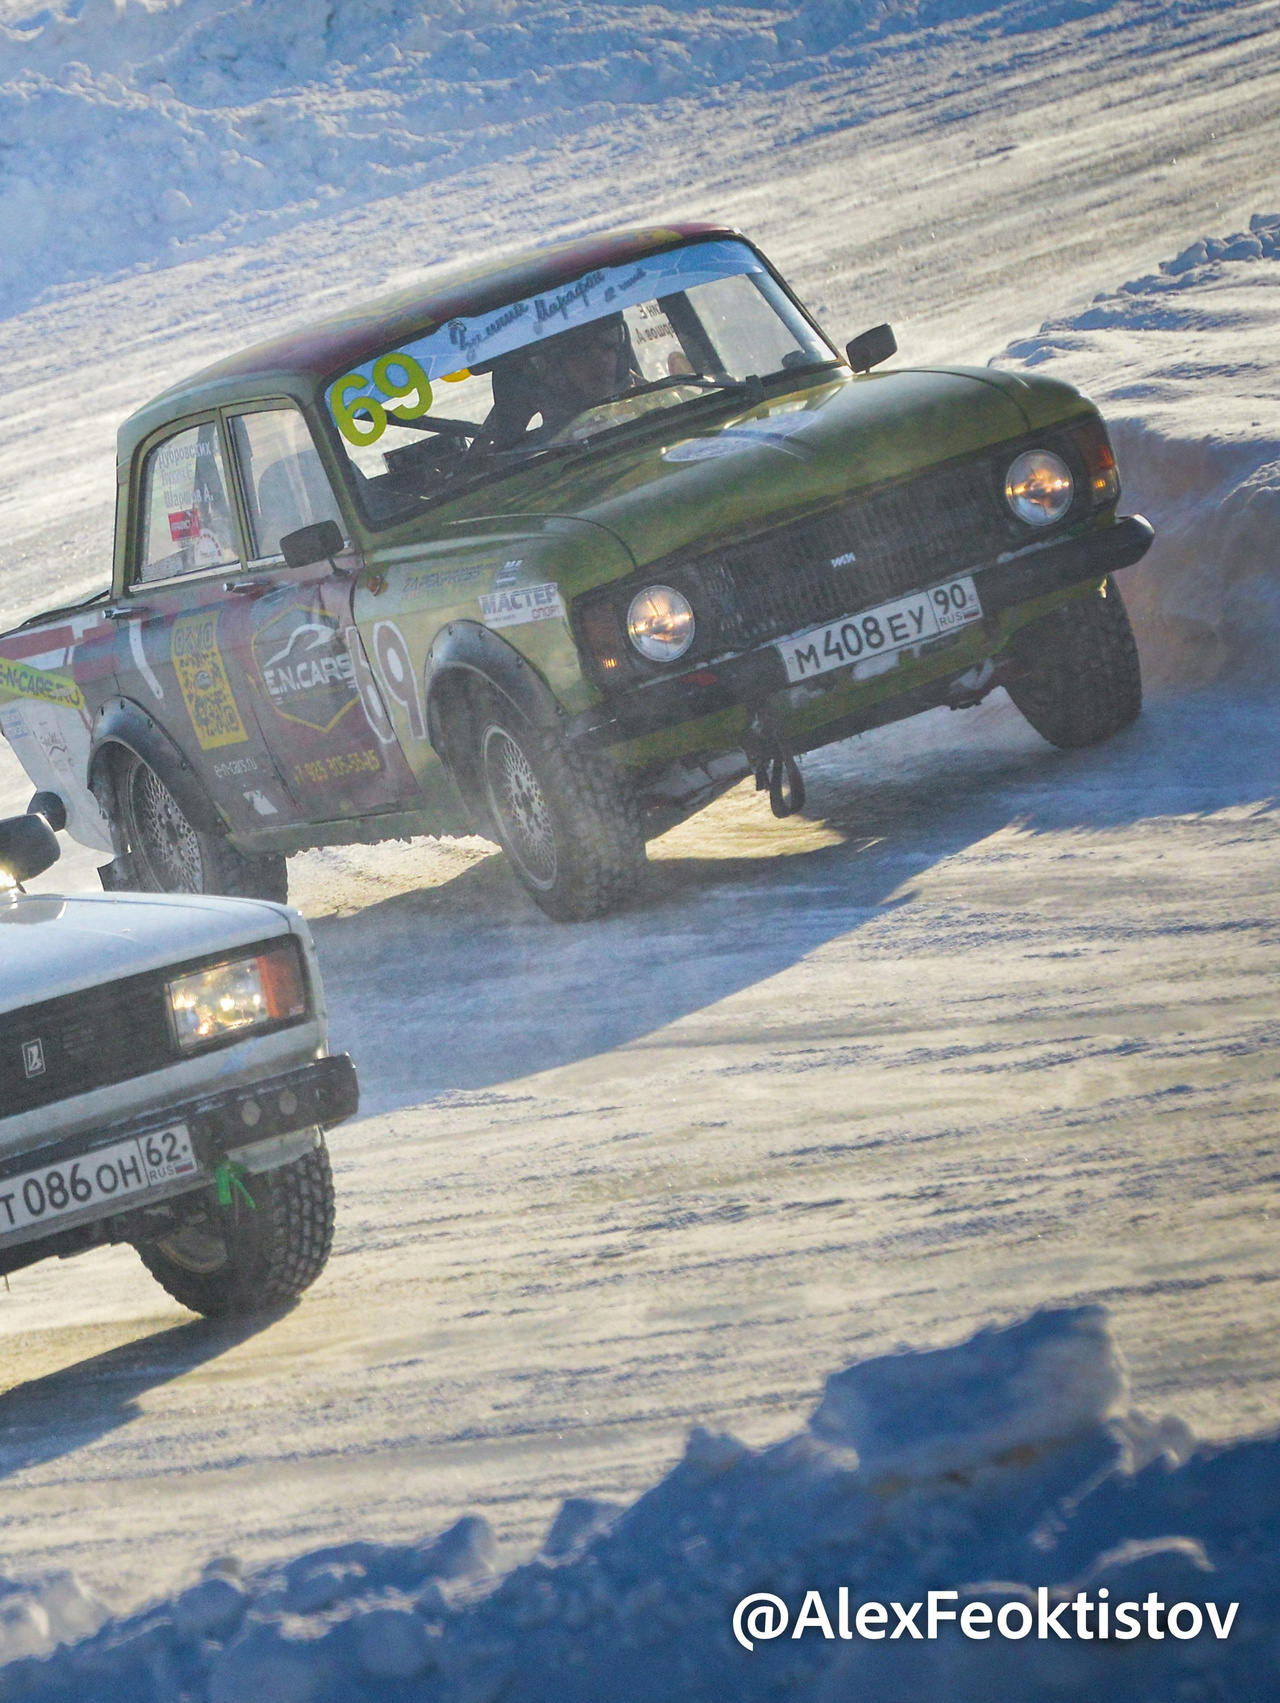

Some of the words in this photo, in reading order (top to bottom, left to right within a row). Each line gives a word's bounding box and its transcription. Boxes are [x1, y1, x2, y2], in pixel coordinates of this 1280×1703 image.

[330, 352, 433, 447] 69
[933, 583, 966, 615] 90
[939, 612, 963, 627] RUS
[794, 605, 924, 674] М408ЕУ
[345, 620, 426, 744] 69
[146, 1132, 181, 1167] 62
[149, 1166, 175, 1181] RUS
